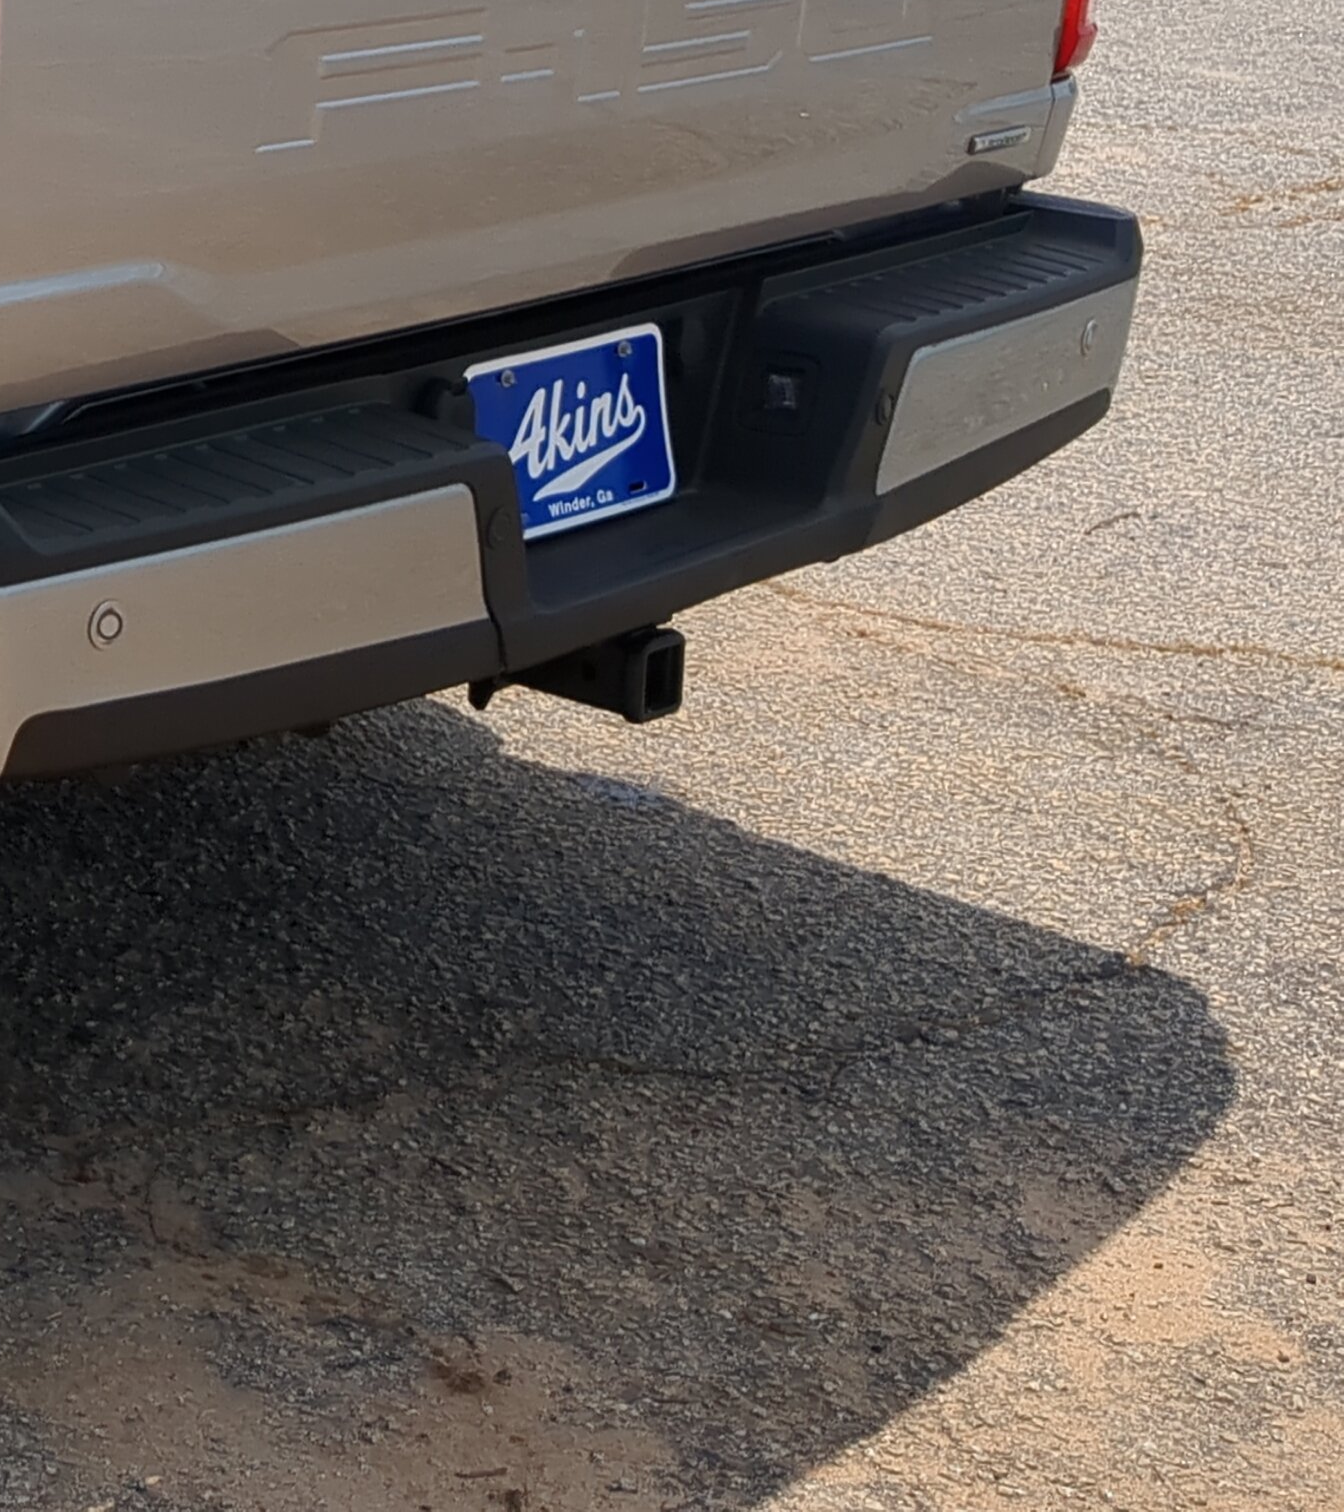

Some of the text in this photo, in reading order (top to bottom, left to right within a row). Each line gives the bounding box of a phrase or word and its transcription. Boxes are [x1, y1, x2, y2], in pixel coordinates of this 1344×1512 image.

[508, 373, 645, 481] Akins
[548, 494, 596, 518] Winder,
[596, 489, 615, 504] Ga
